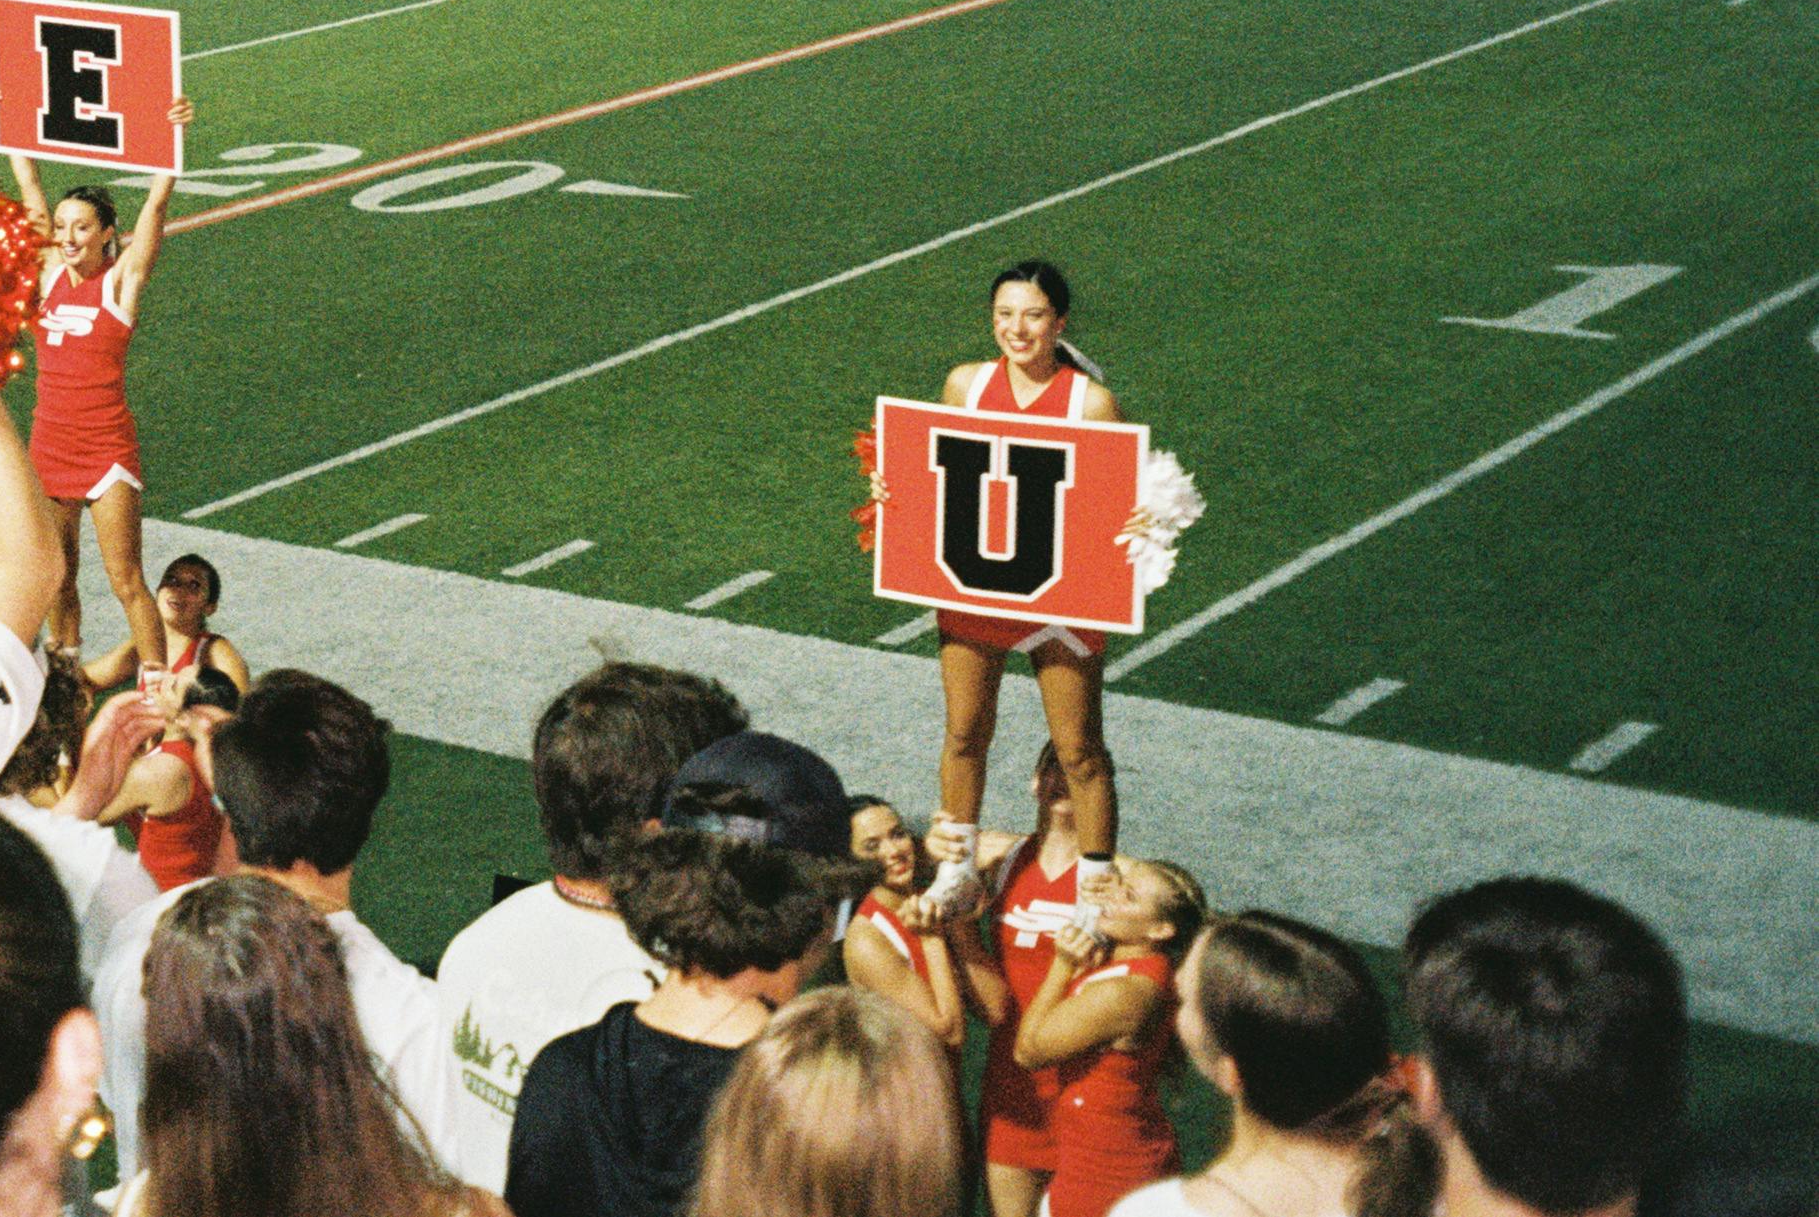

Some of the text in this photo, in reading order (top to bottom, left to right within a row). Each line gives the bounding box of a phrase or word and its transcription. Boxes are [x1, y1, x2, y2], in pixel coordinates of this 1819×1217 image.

[35, 15, 124, 155] E
[105, 142, 564, 212] 20
[1439, 263, 1684, 340] 1
[929, 427, 1076, 603] U
